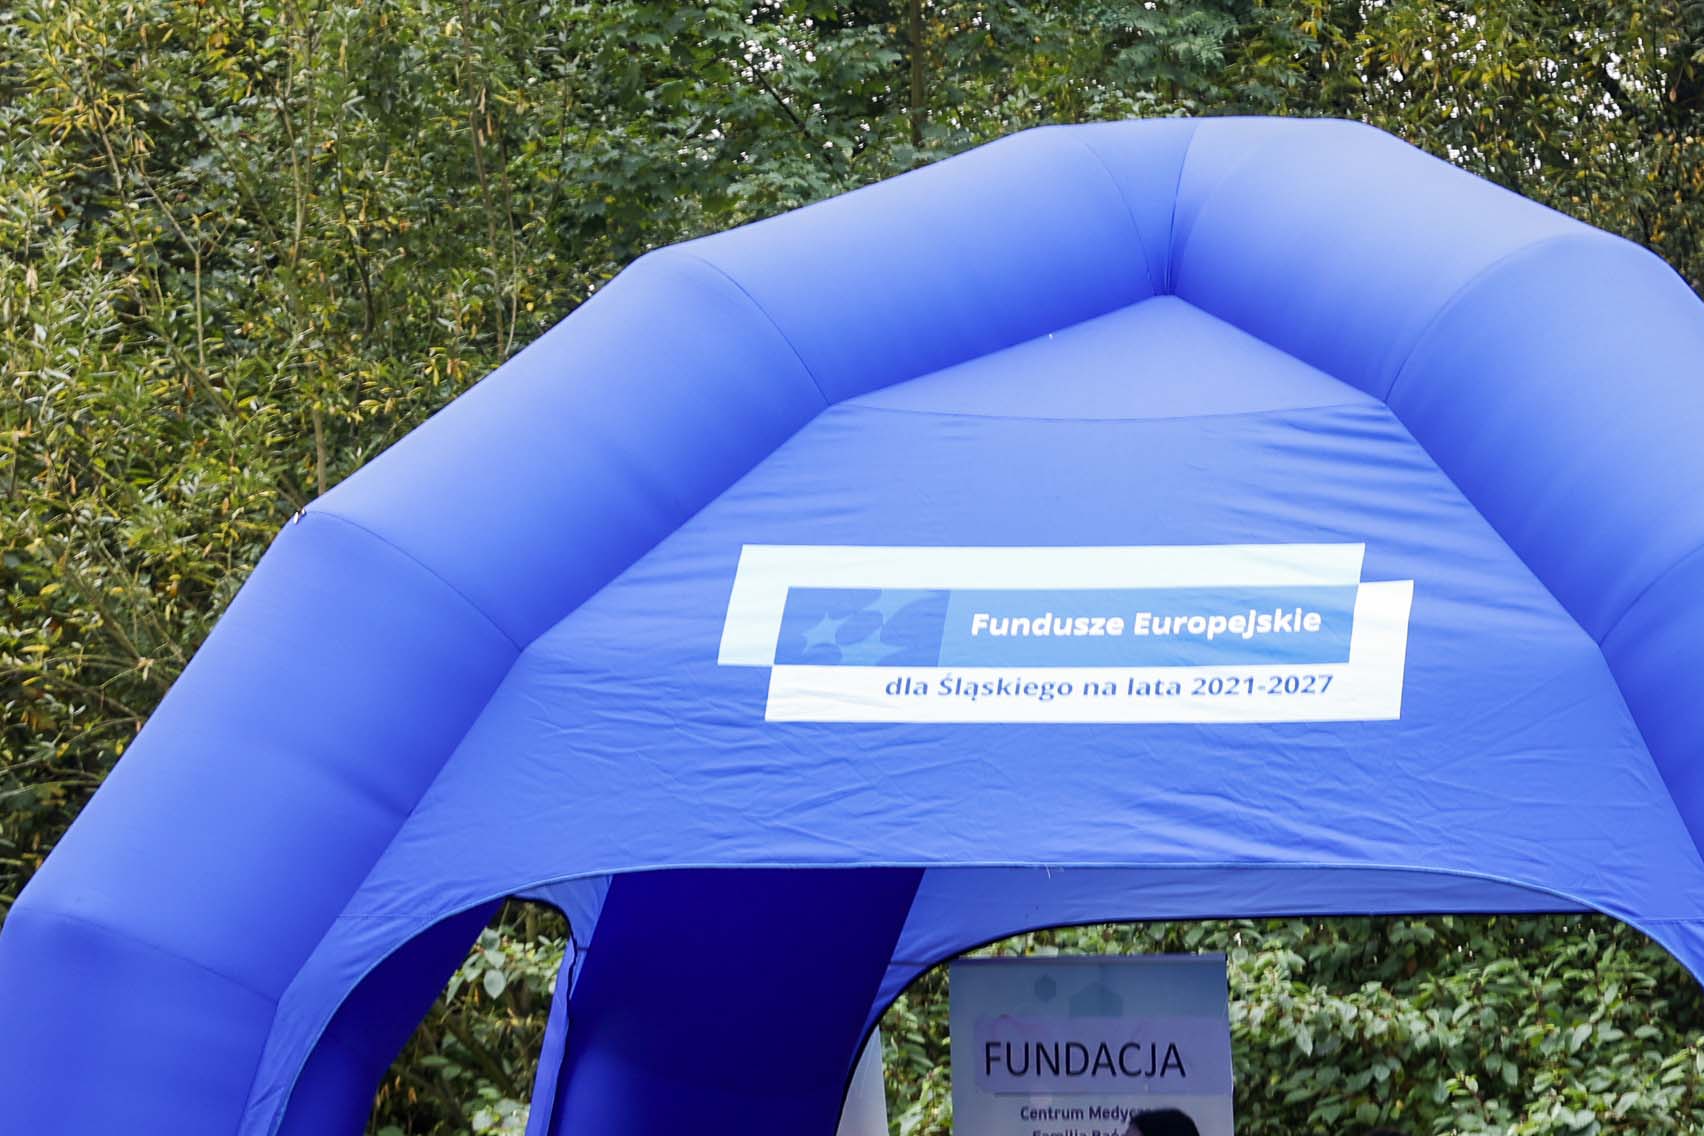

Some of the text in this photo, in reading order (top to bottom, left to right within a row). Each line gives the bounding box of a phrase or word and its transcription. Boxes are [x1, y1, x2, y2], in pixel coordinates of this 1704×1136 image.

[970, 608, 1320, 641] Fundusze Europejskie
[884, 673, 1333, 701] dla Śląskiego na lata 2021-2027
[984, 1041, 1186, 1078] FUNDACJA
[1019, 1105, 1138, 1123] Centrum Medyc
